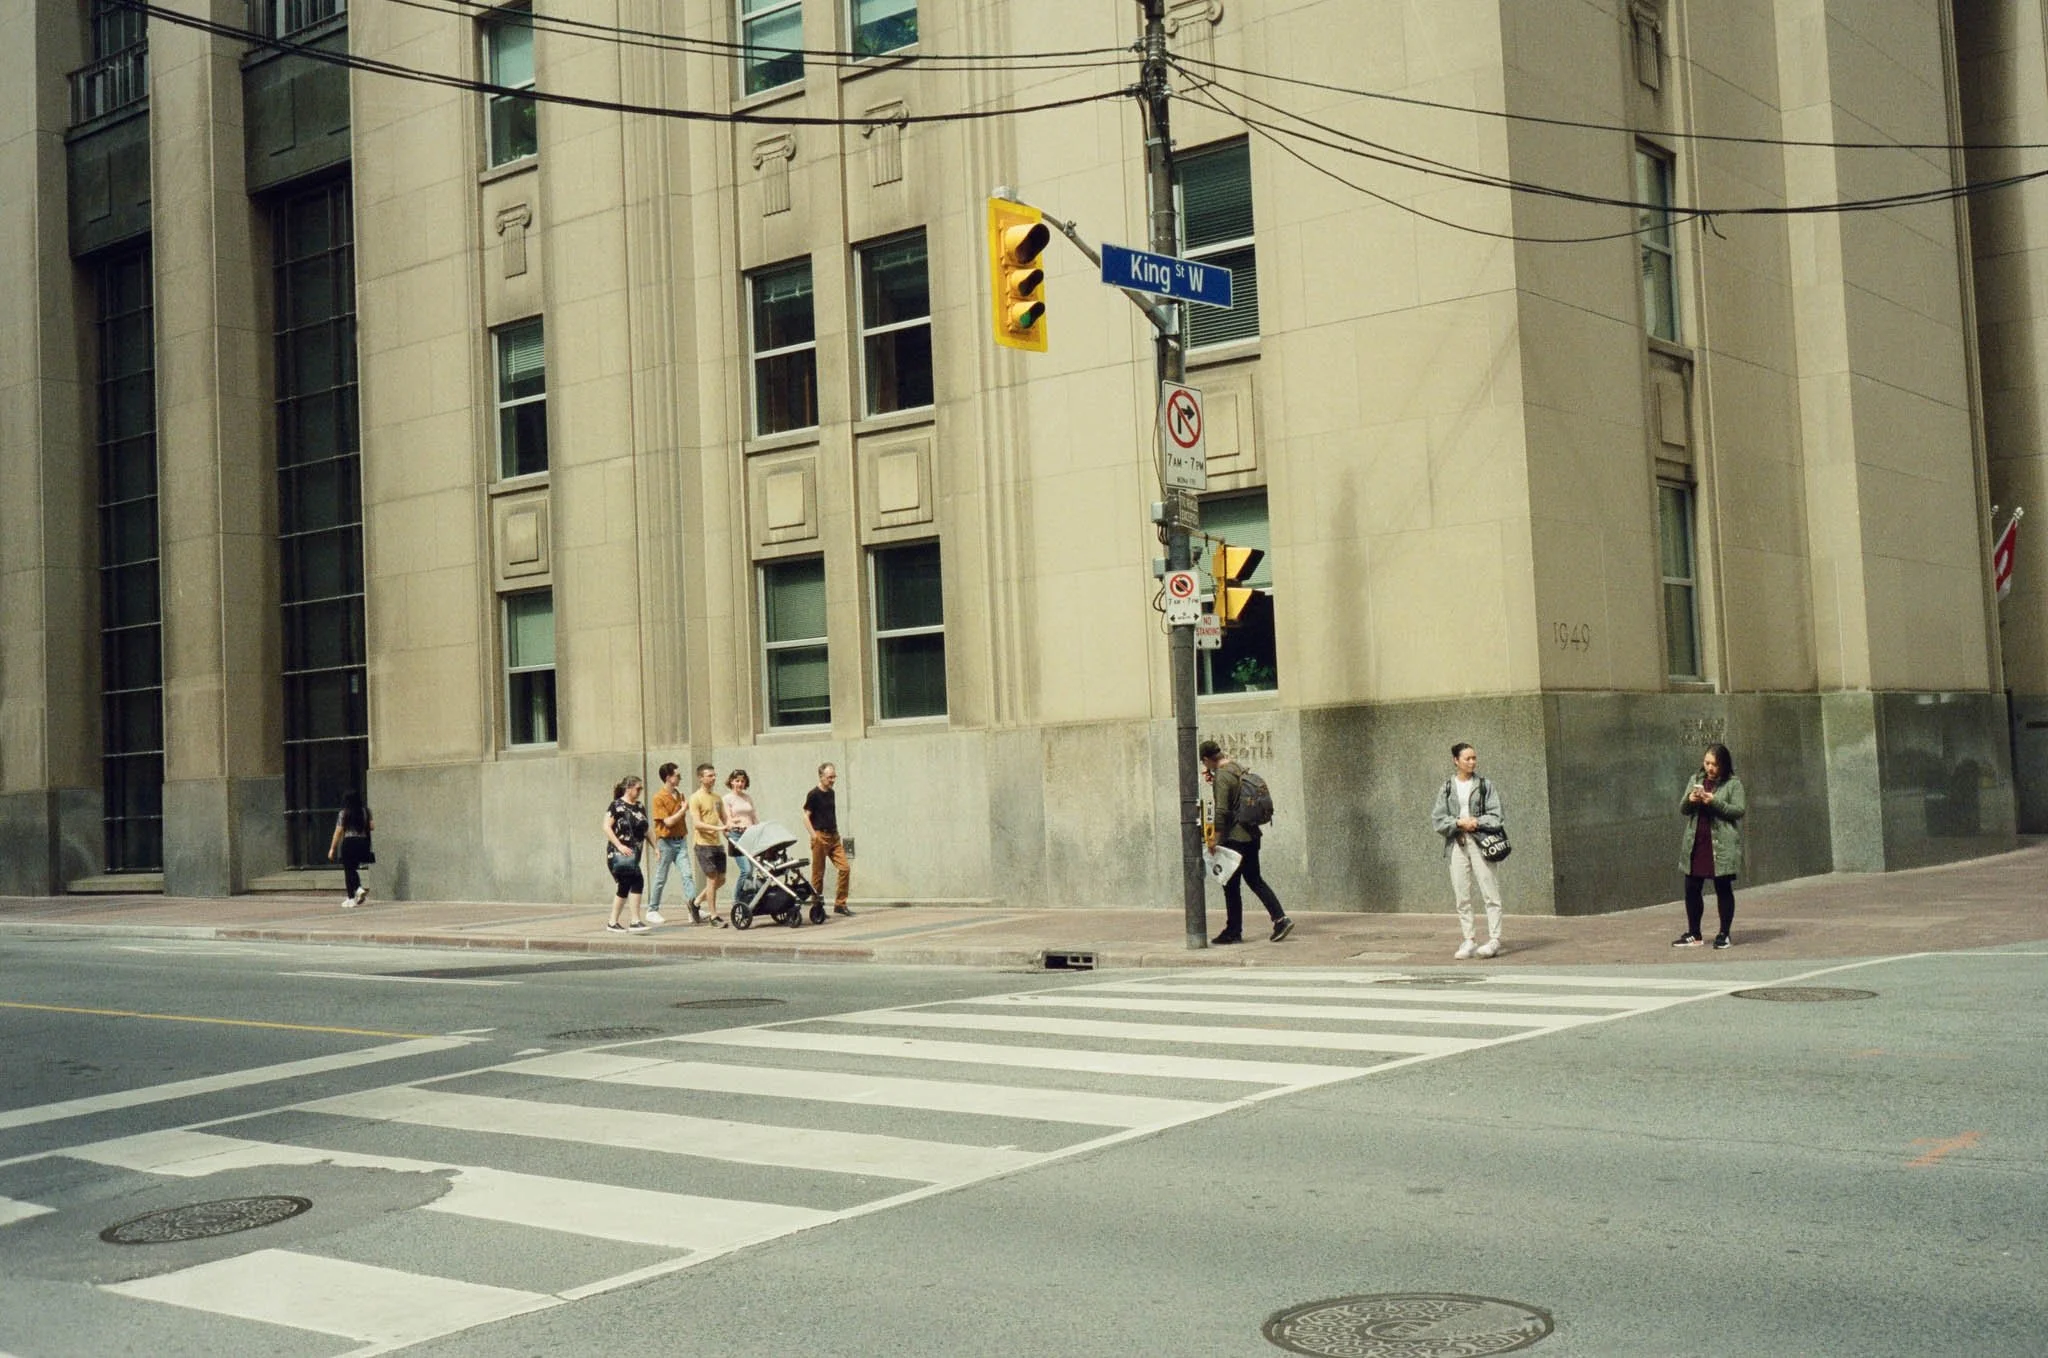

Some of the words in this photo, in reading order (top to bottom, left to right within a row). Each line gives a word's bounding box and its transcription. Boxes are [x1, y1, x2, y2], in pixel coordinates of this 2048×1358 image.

[1131, 254, 1171, 293] King
[1175, 264, 1185, 278] St
[1188, 266, 1204, 293] W
[1203, 616, 1212, 625] NO
[1553, 622, 1590, 652] 1949
[1254, 730, 1273, 744] OF
